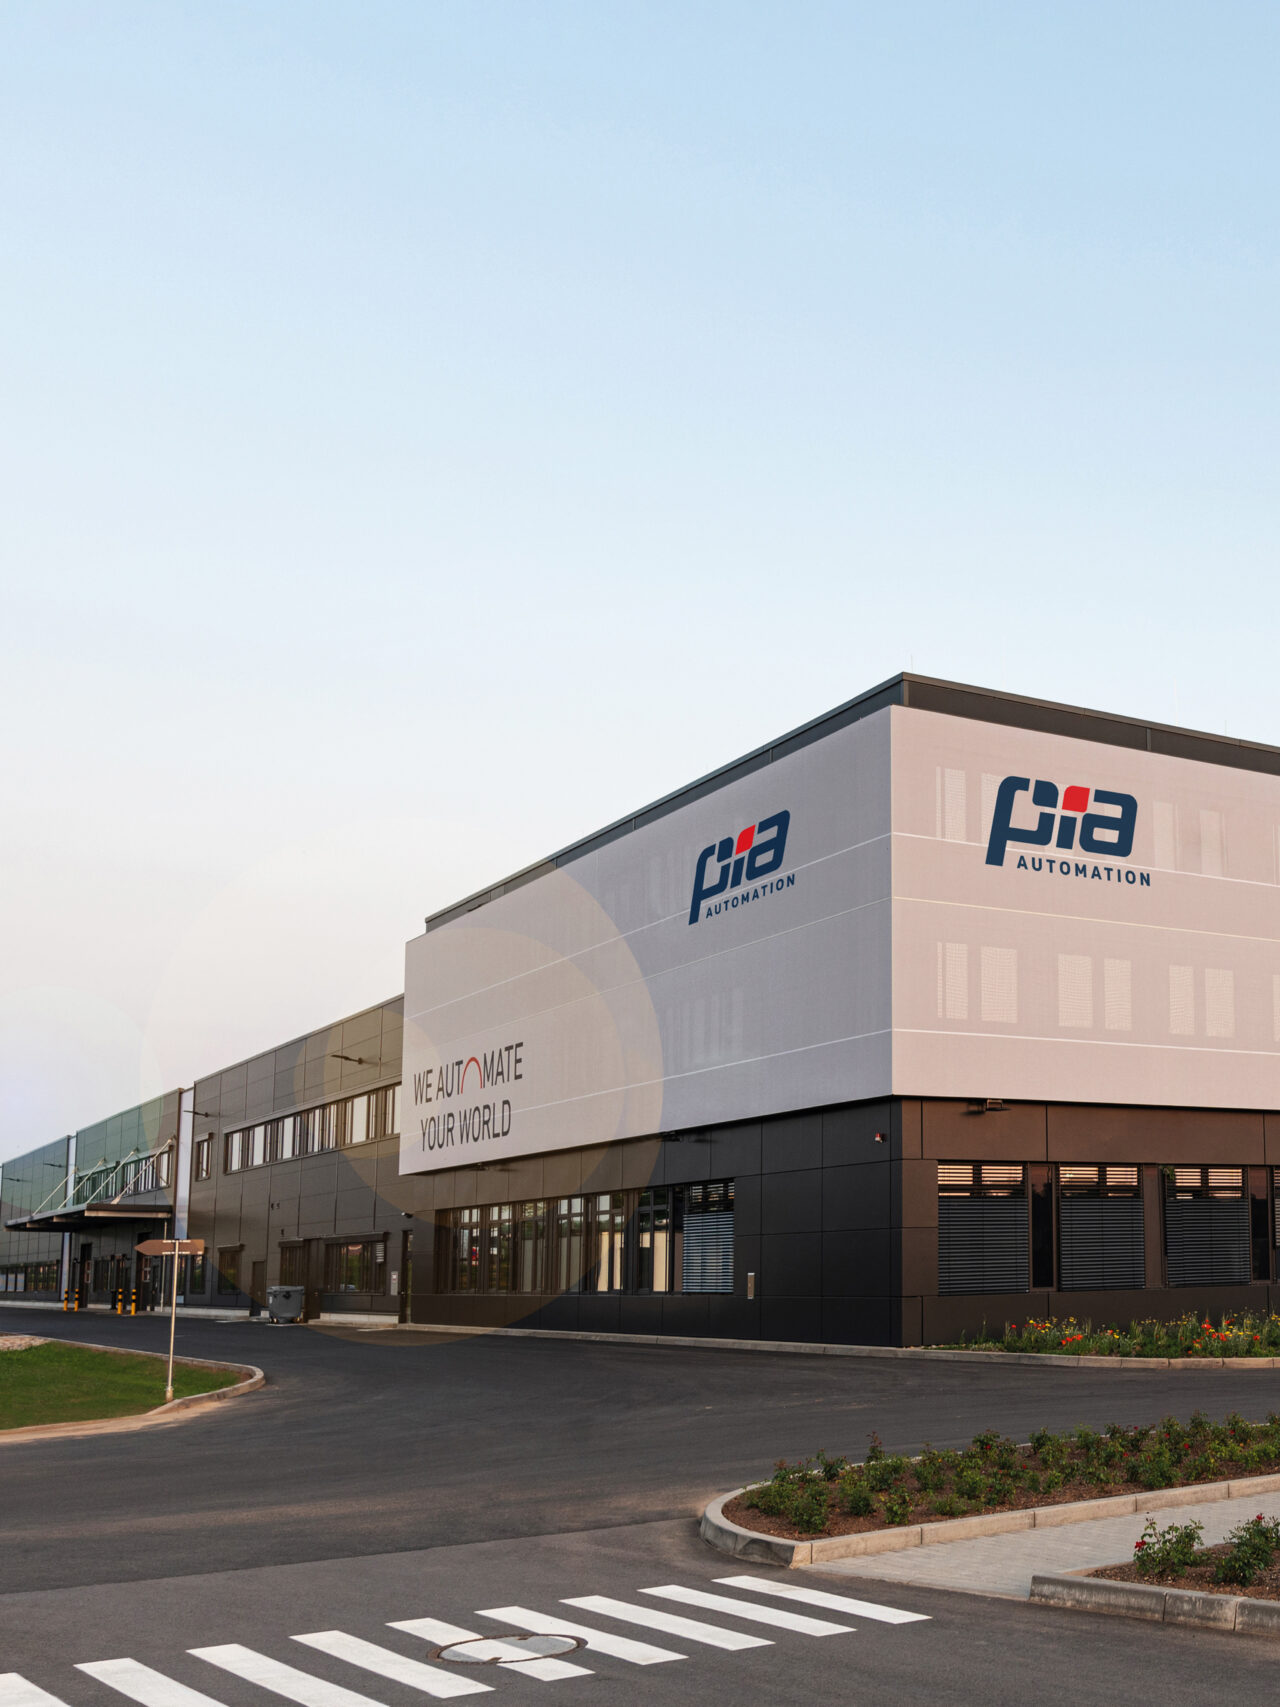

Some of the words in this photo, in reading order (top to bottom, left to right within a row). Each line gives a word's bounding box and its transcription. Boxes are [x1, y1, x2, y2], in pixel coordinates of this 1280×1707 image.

[1016, 855, 1151, 887] AUTOMATION
[705, 873, 796, 919] AUTOMATION
[413, 1068, 433, 1106] WE
[420, 1112, 455, 1152] YOUR
[459, 1099, 512, 1145] WORLD
